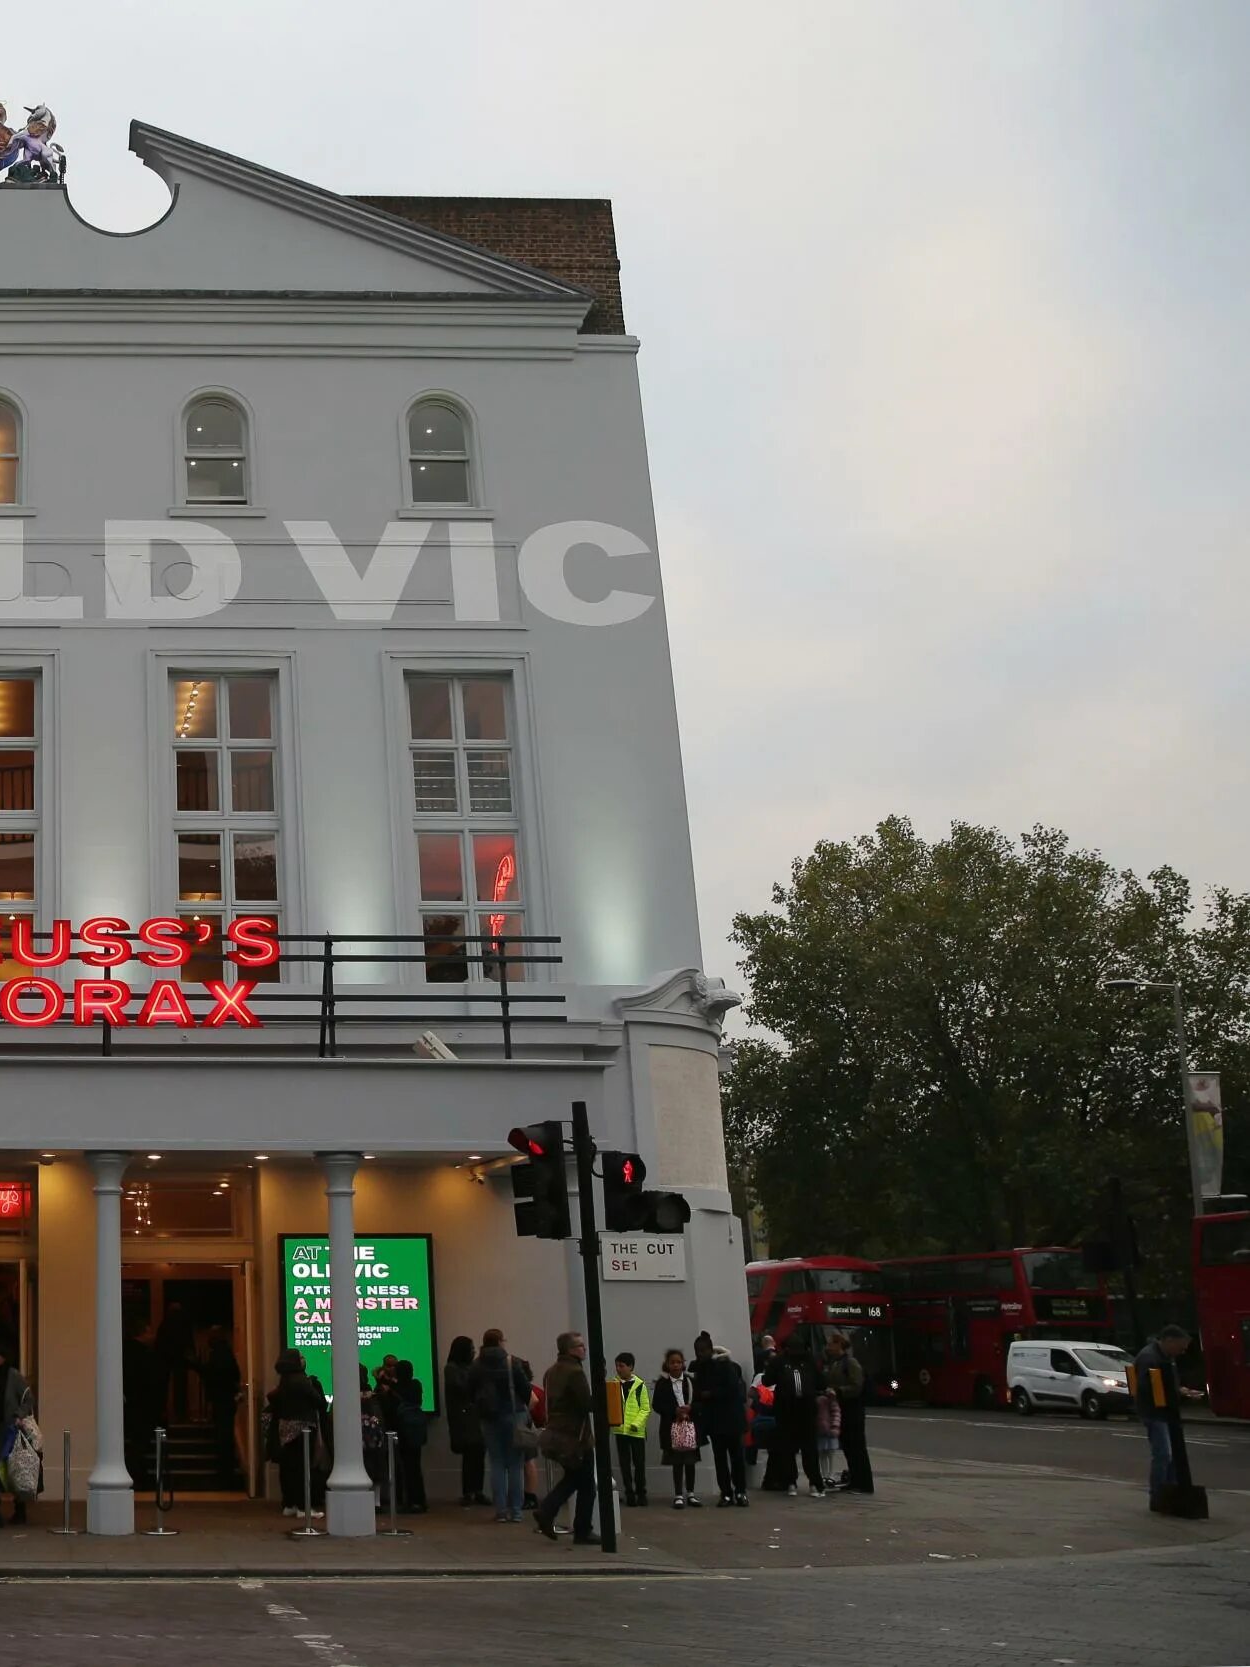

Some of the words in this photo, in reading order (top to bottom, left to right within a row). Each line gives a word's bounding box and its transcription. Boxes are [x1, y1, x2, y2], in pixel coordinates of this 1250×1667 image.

[282, 519, 655, 626] VIC
[292, 1246, 322, 1260] AT
[611, 1243, 638, 1254] THE
[647, 1243, 674, 1255] CUT
[292, 1263, 330, 1278] OL
[612, 1260, 637, 1271] SE1
[367, 1285, 409, 1295] NESS
[293, 1297, 308, 1310] A
[315, 1297, 418, 1310] MNSTER
[868, 1306, 881, 1317] 168
